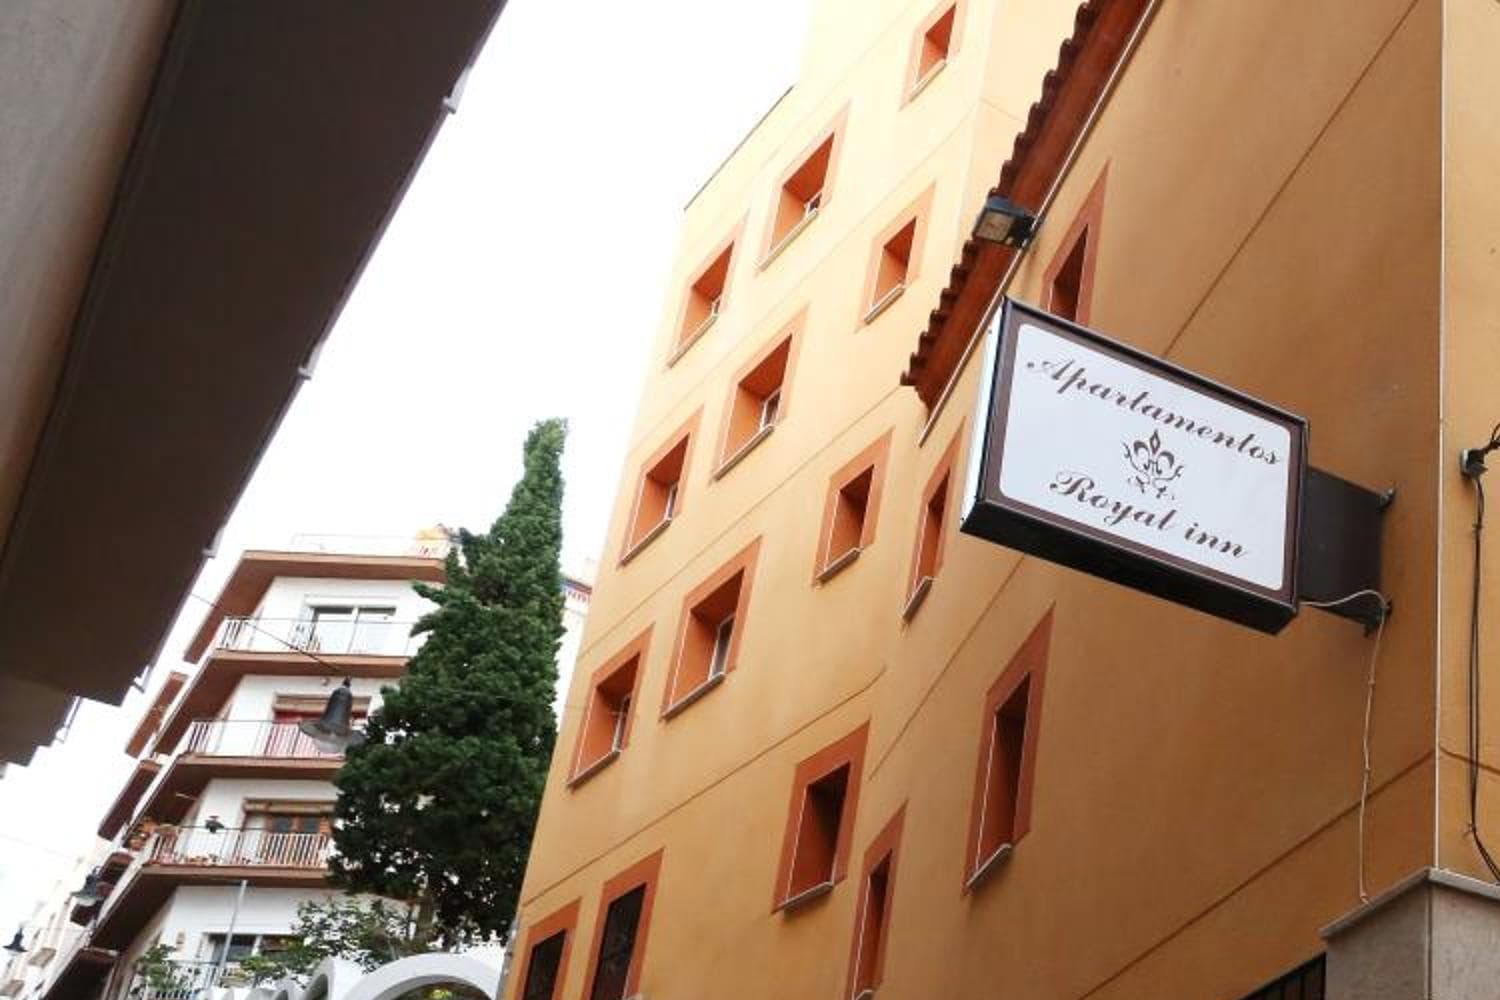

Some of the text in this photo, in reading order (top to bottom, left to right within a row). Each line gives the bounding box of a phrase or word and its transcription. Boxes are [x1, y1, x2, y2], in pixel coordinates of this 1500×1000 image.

[1027, 358, 1279, 465] Apartamentos
[1050, 471, 1247, 559] Royal inn
